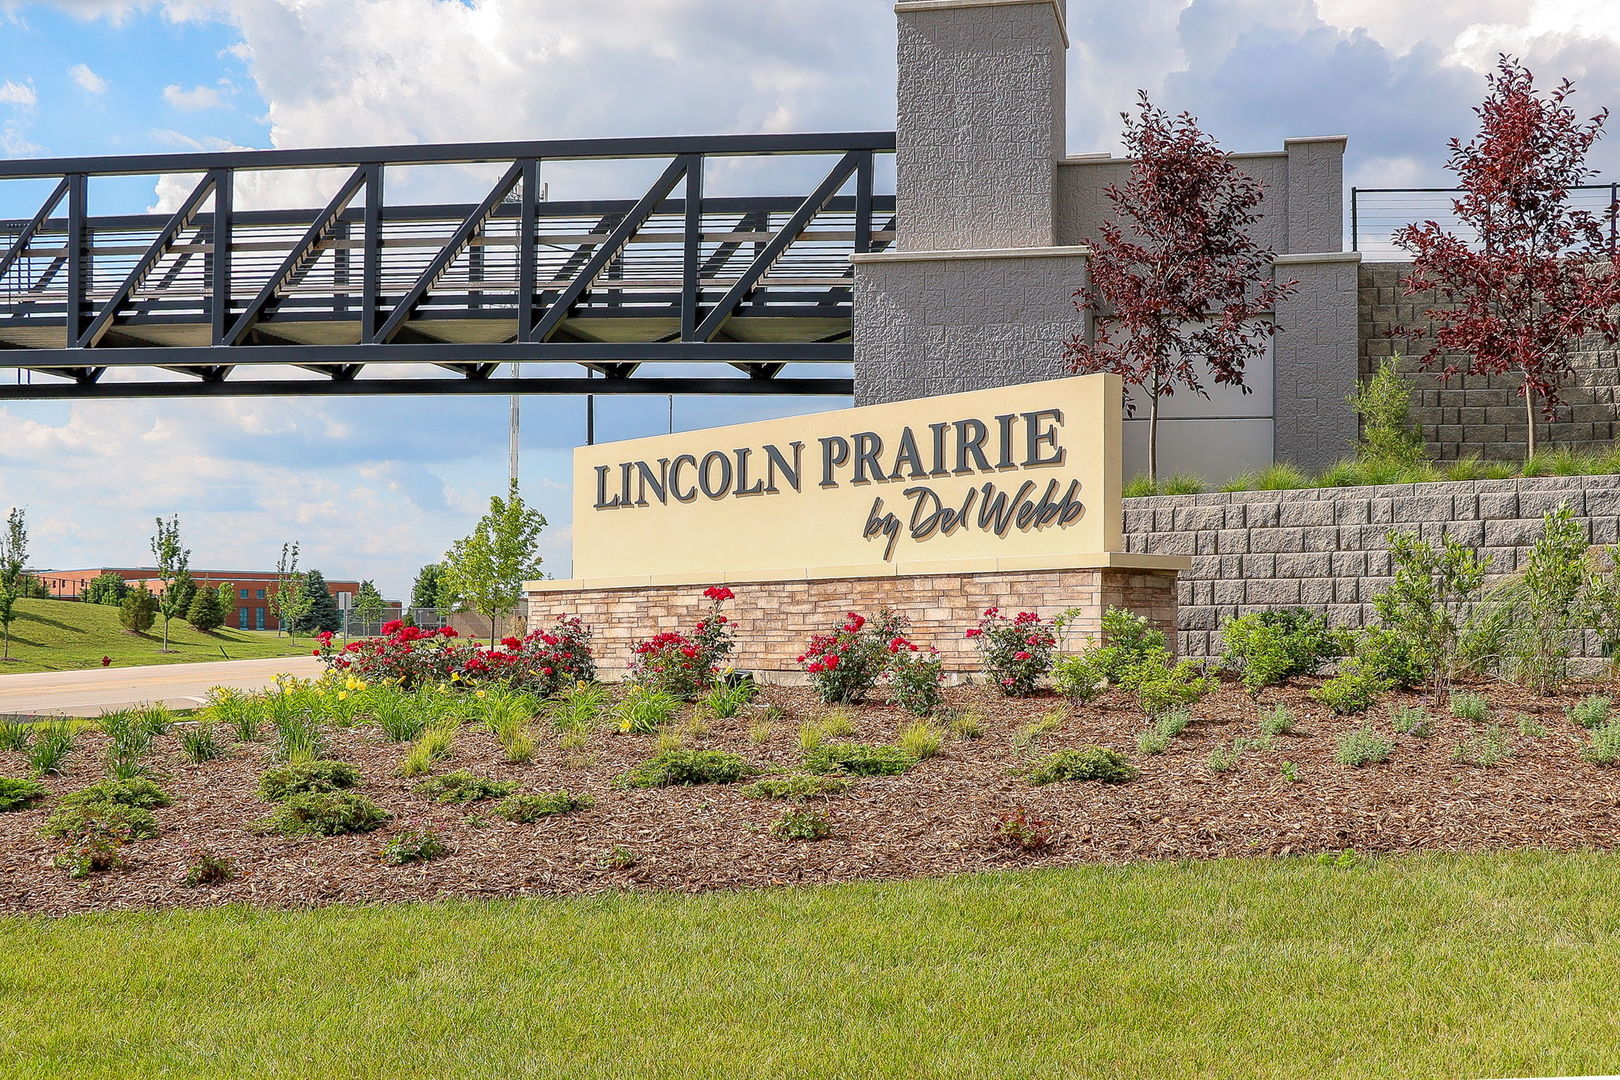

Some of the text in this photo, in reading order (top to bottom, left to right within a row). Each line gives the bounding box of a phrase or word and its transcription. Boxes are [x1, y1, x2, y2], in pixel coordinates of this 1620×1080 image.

[593, 408, 1064, 507] LINCOLN PRAIRIE
[863, 478, 1084, 560] by Del Webb
